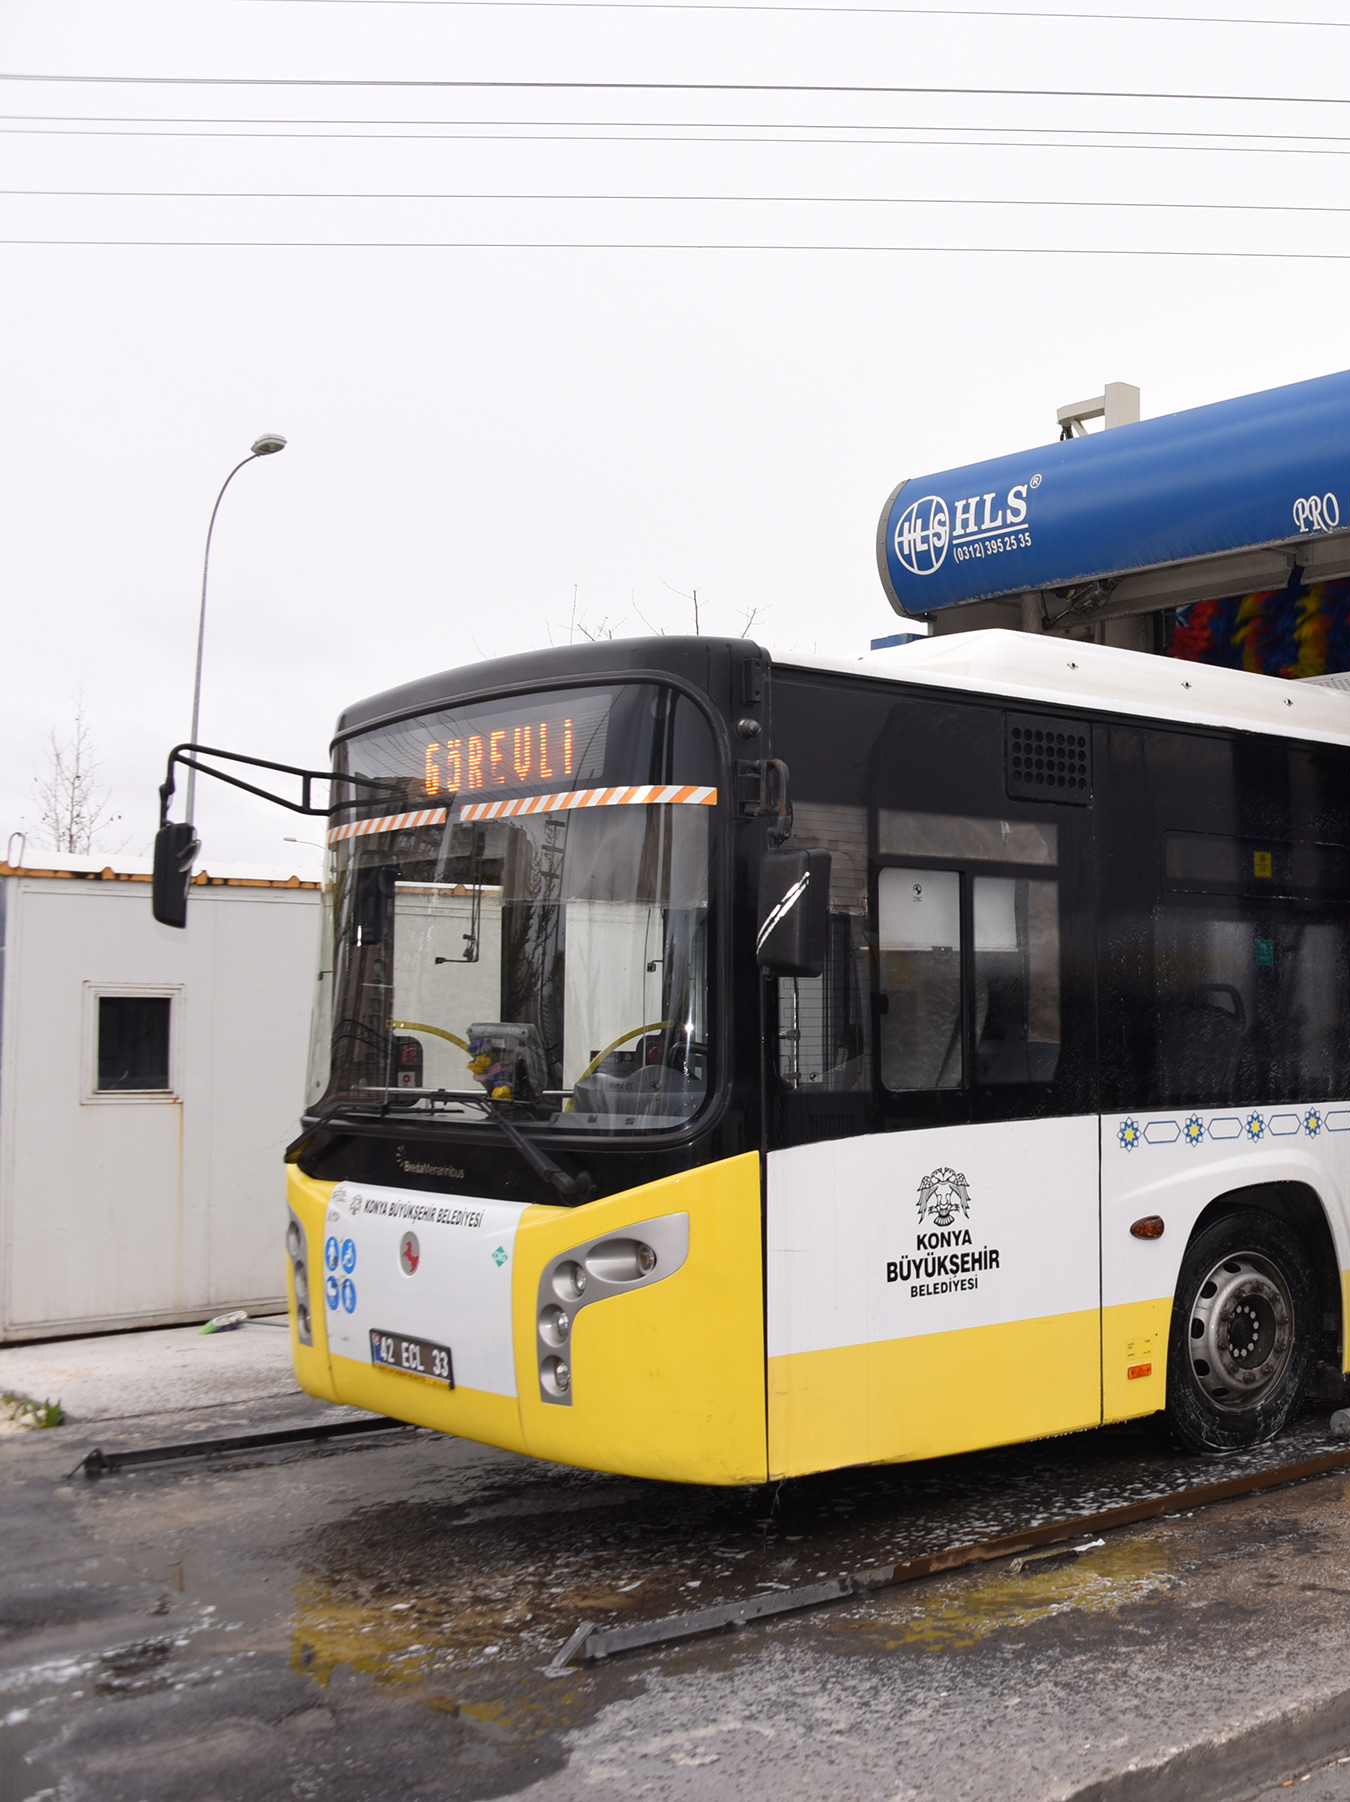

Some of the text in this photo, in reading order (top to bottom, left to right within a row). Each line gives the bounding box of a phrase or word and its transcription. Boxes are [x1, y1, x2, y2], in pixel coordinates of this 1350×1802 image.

[953, 484, 1028, 537] HLS
[1293, 492, 1340, 534] PRO
[901, 512, 950, 556] HLS
[954, 532, 1032, 564] (0312) 395 25 35
[425, 718, 573, 795] GÖREVLİ
[363, 1199, 486, 1229] KONYA BÜYÜKŞEHİR BELEDİYESİ
[917, 1229, 972, 1251] KONYA
[886, 1245, 1000, 1283] BÜYÜKŞEHİR
[910, 1274, 978, 1298] BELEDİYESİ
[380, 1336, 449, 1377] 42 ECL 33
